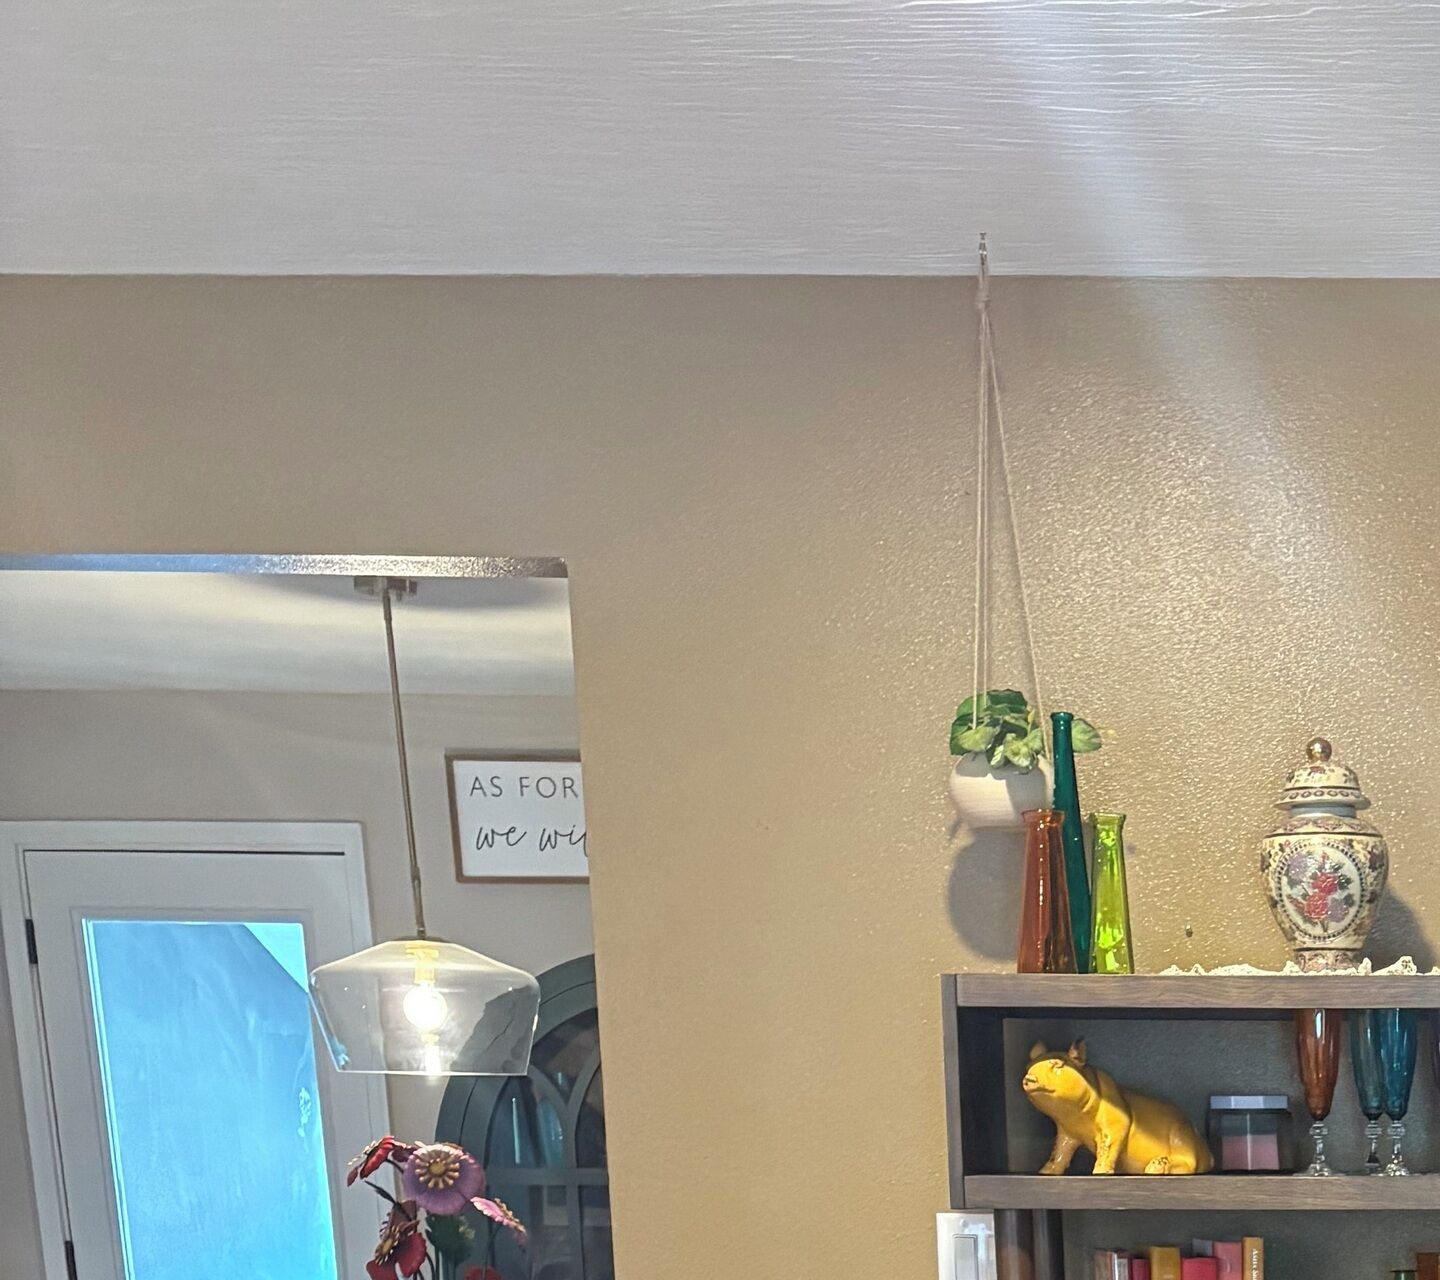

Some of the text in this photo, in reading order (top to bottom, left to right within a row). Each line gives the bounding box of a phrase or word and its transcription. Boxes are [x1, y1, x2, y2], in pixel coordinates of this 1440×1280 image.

[470, 776, 578, 798] AS FOR
[476, 826, 527, 850] we
